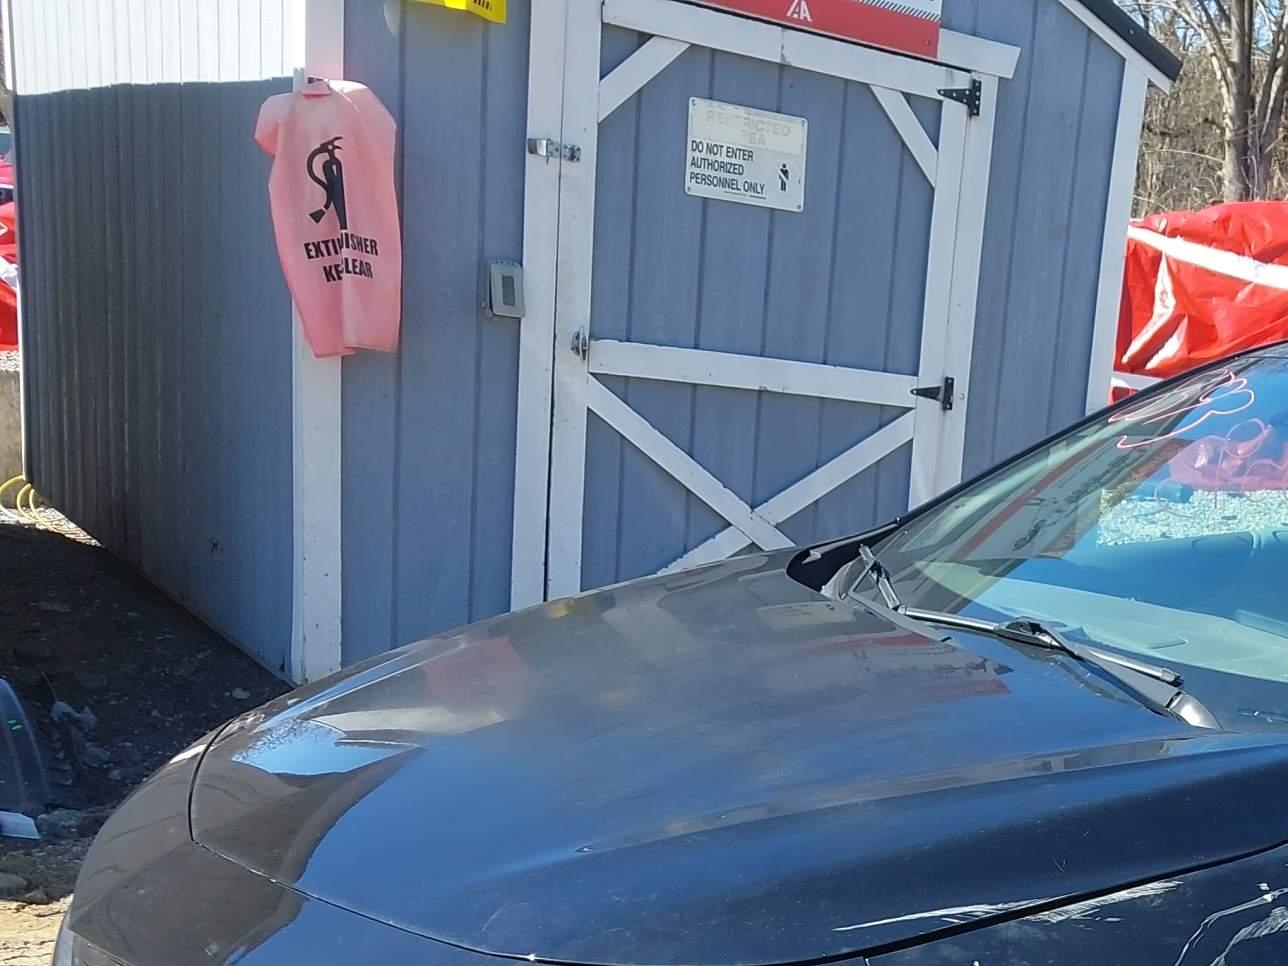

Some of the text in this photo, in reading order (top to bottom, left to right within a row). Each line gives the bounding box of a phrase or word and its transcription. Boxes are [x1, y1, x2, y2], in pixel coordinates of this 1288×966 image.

[691, 139, 754, 162] DO NOT ENTER
[690, 156, 745, 176] AUTHORIZED
[689, 171, 741, 191] PERSONNEL
[743, 180, 766, 195] ONLY
